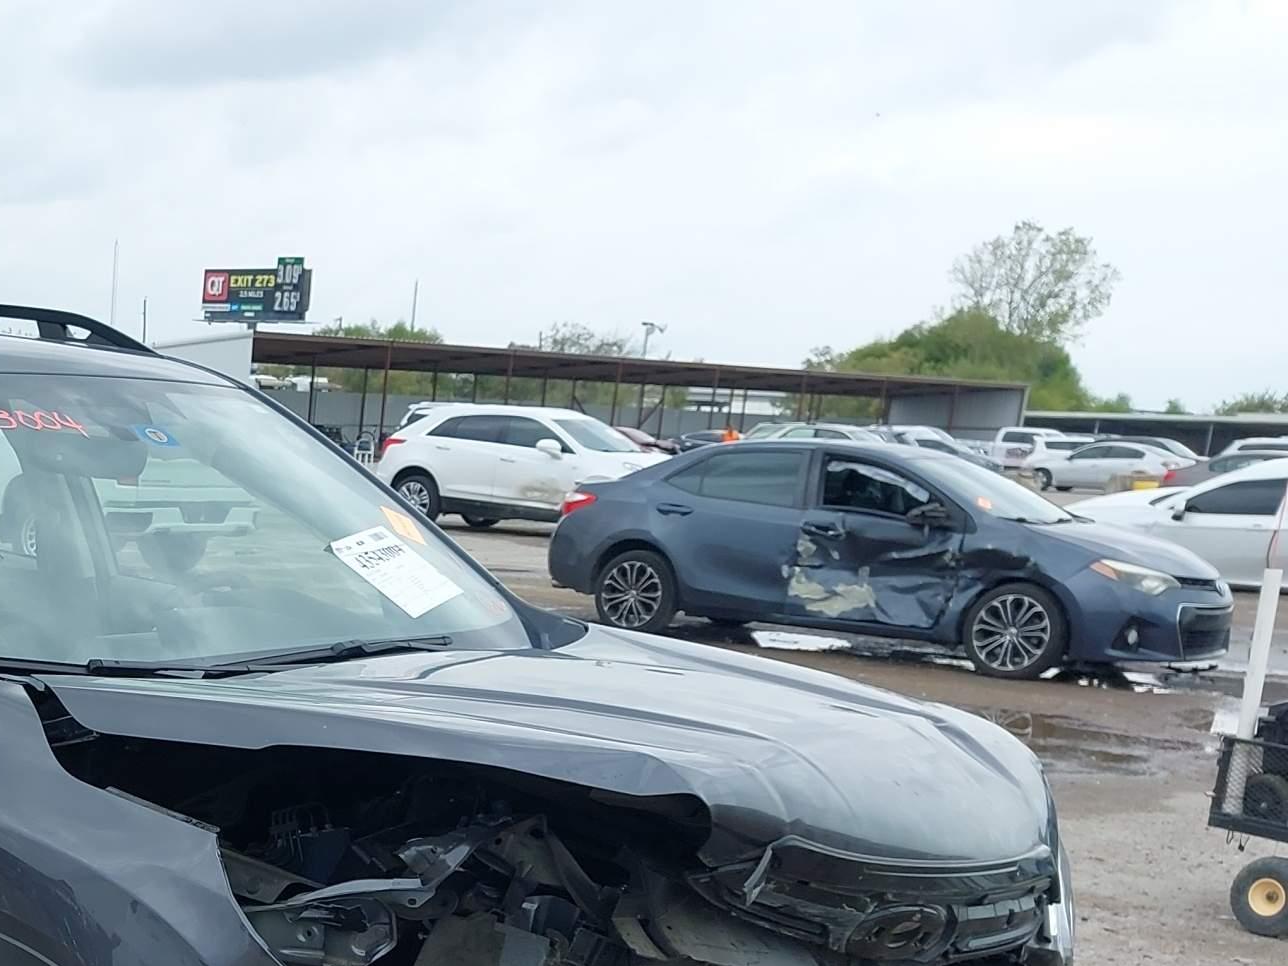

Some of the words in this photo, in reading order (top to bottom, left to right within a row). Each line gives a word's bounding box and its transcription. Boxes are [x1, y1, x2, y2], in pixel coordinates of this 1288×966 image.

[208, 276, 225, 297] QT
[230, 275, 254, 288] EXIT
[254, 274, 276, 287] 273
